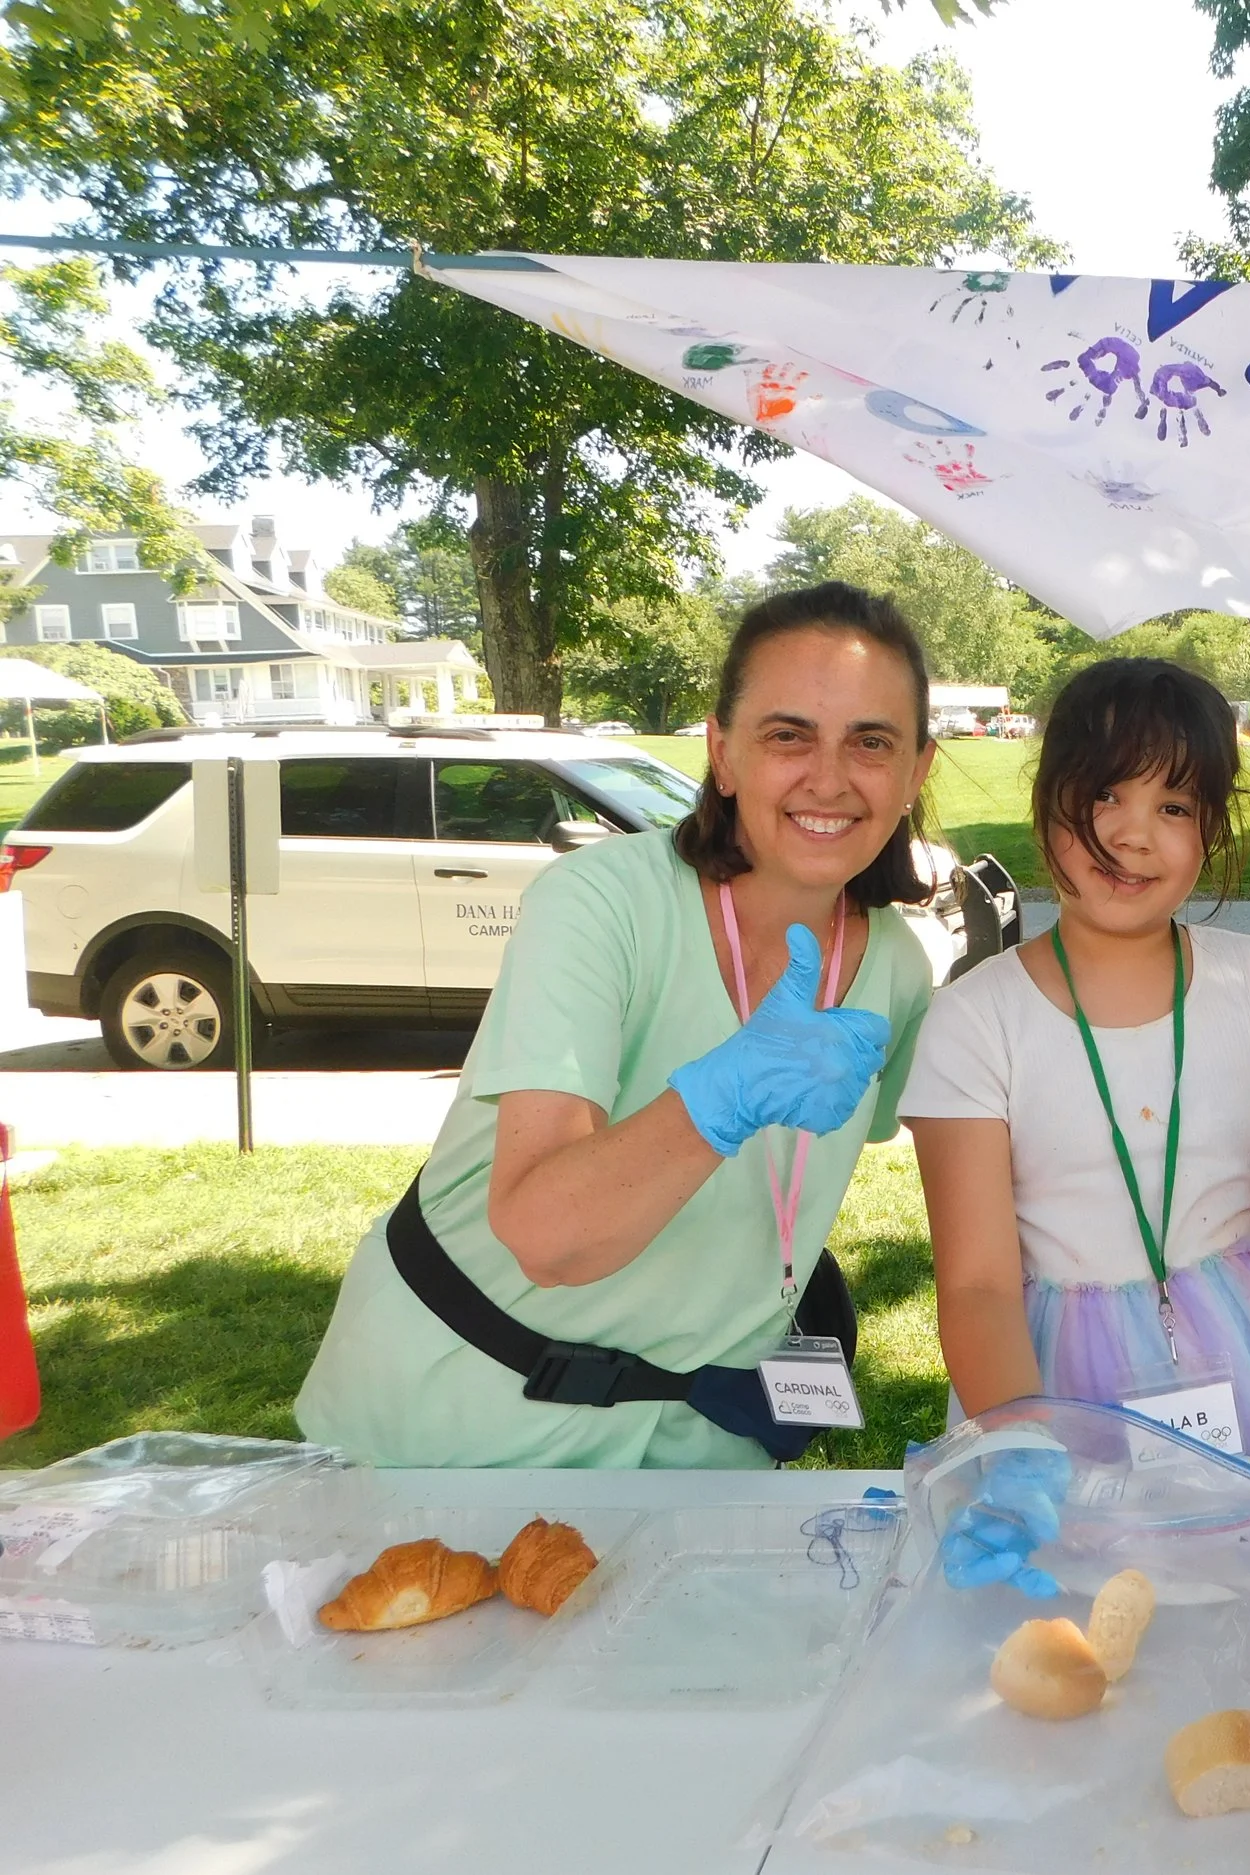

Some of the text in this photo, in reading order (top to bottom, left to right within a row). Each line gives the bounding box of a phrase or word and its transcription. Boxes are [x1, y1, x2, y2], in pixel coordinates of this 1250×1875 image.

[1113, 321, 1142, 346] CELIA
[1169, 335, 1214, 369] MATILDA
[456, 903, 496, 919] DANA
[774, 1382, 841, 1397] CARDINAL
[1160, 1412, 1208, 1430] LA B
